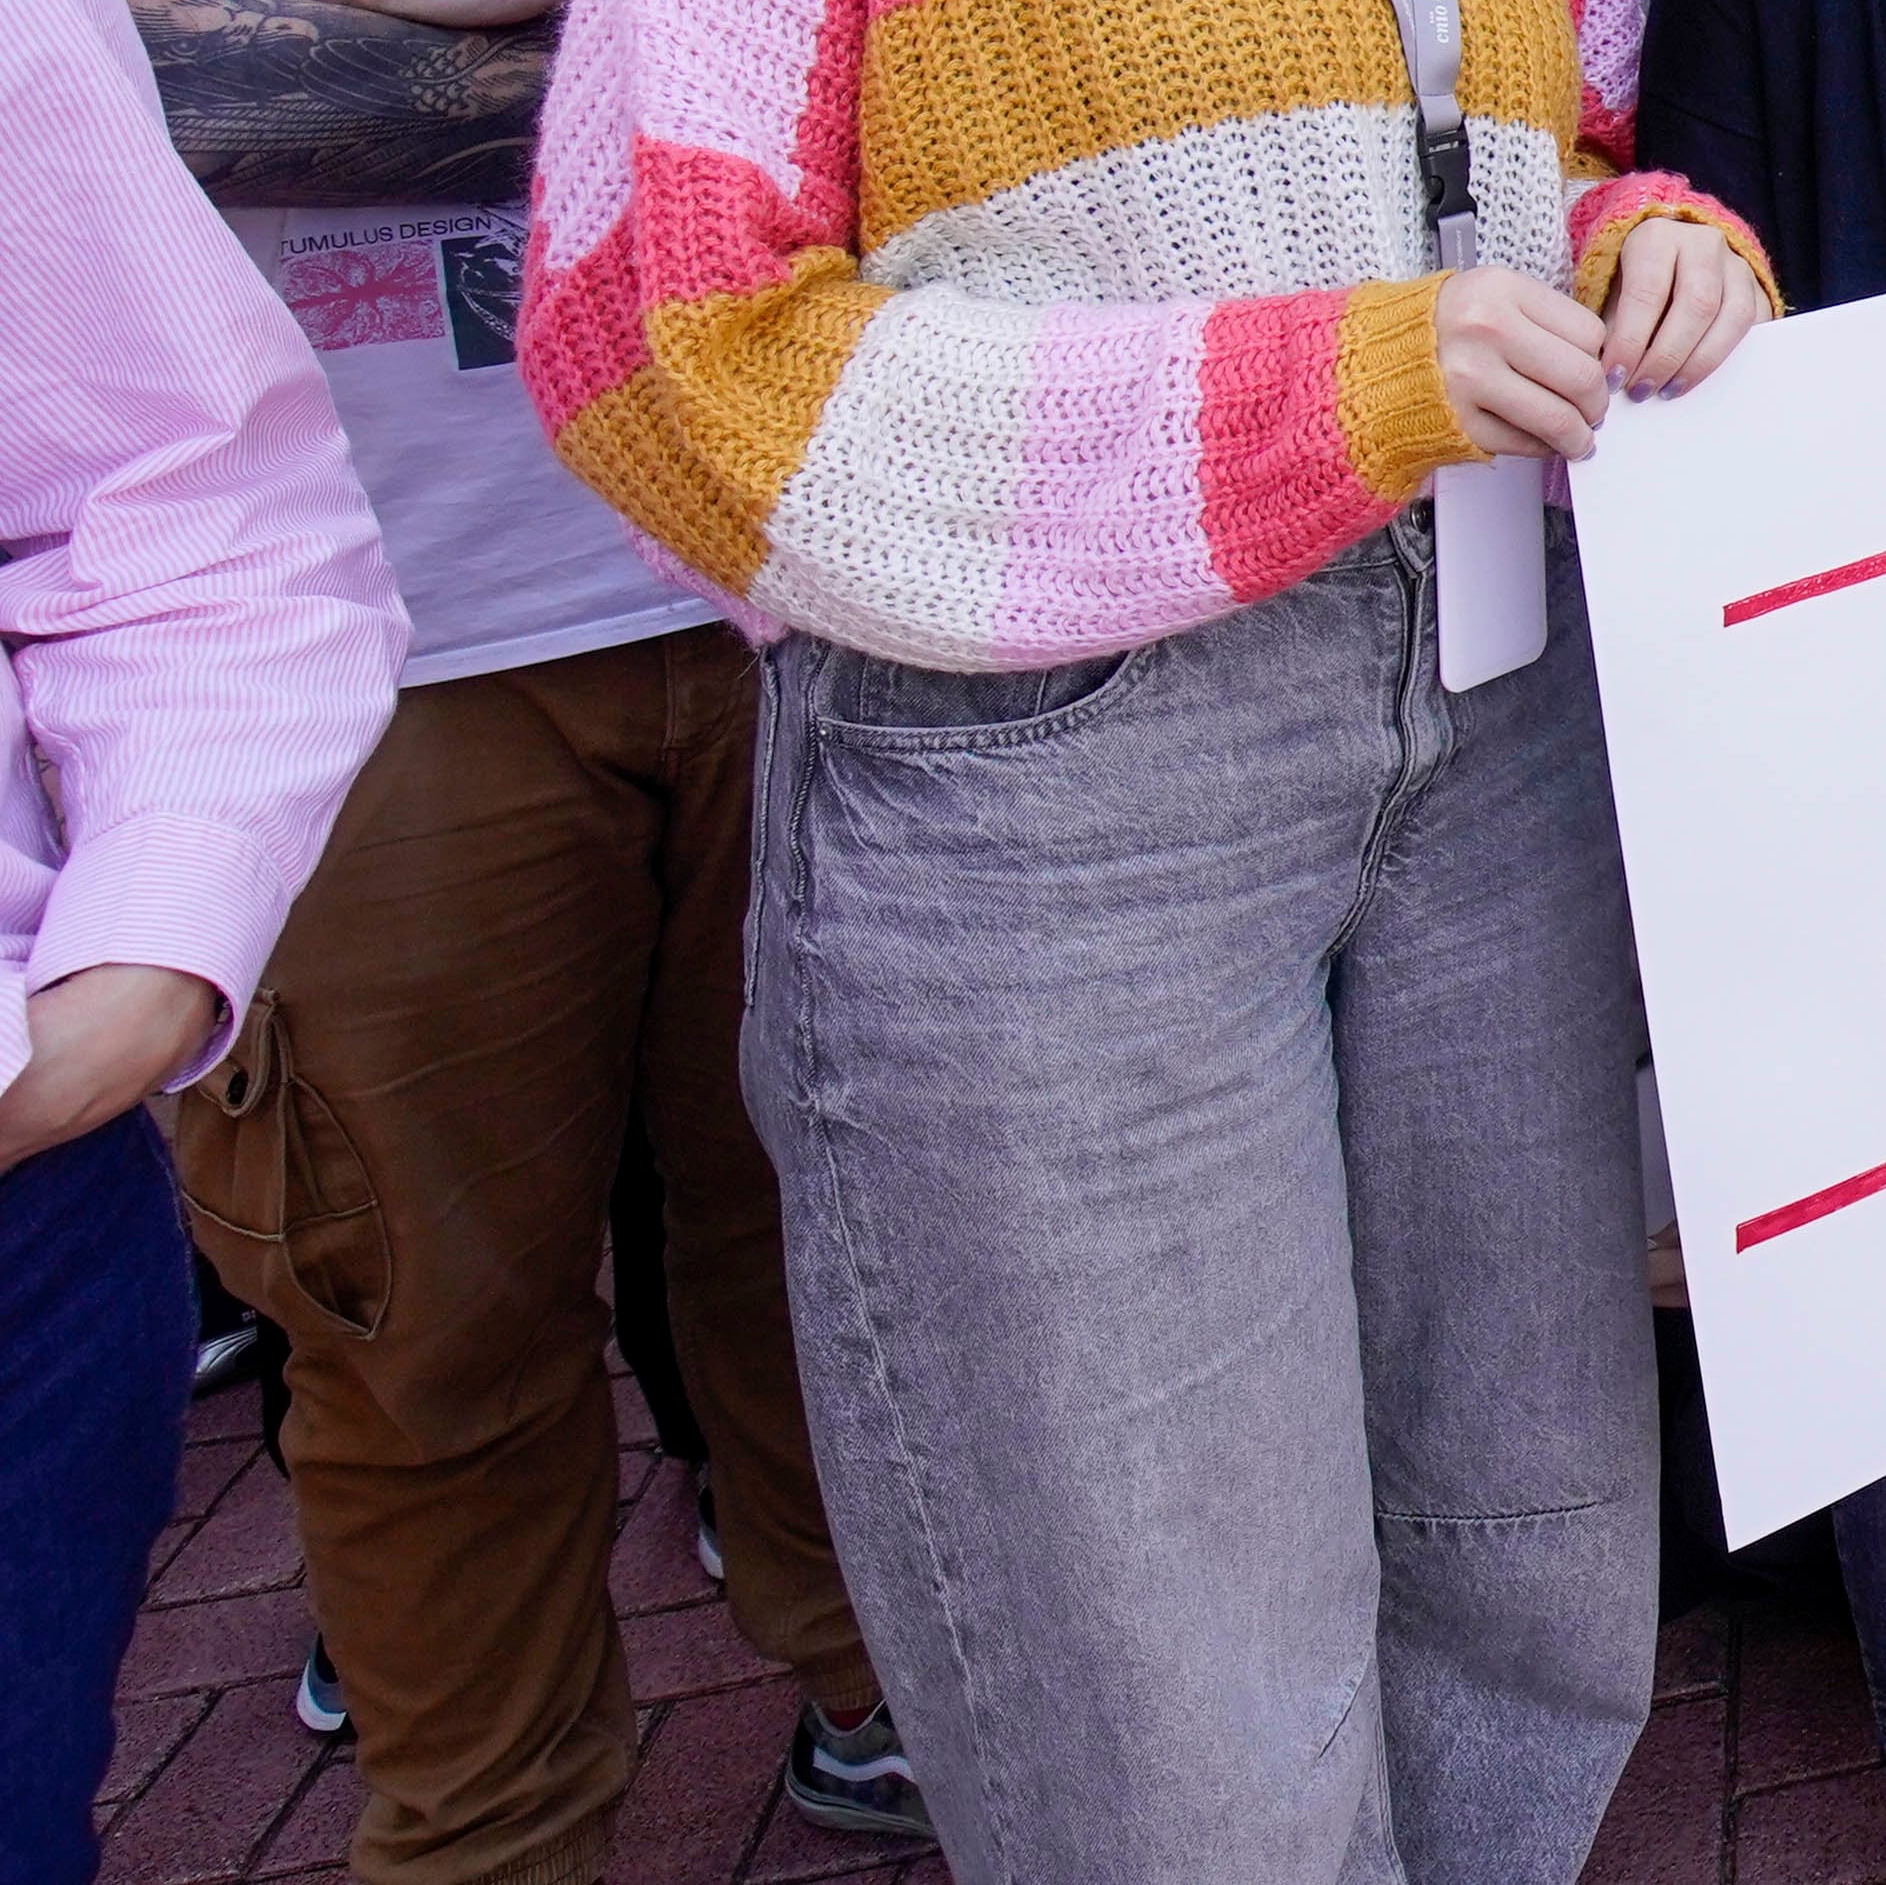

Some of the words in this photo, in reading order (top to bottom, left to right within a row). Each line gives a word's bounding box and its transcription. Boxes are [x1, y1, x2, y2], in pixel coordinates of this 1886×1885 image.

[1429, 5, 1449, 44] cnio
[280, 226, 393, 255] TUMULUS
[400, 216, 492, 240] DESIGN
